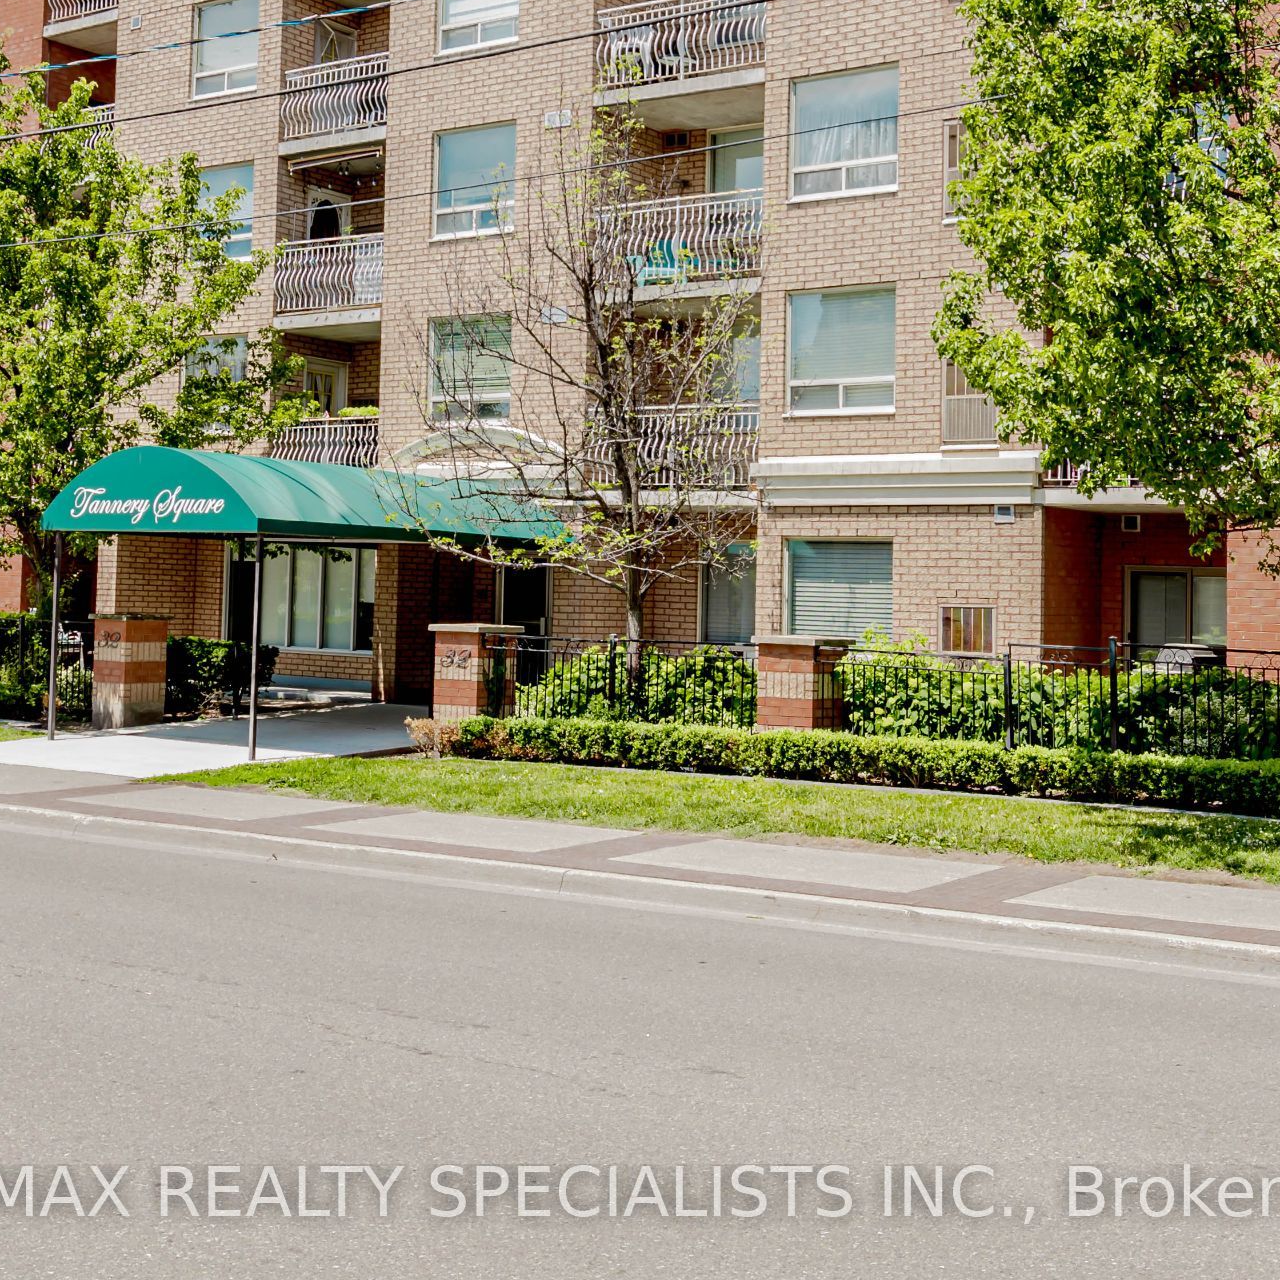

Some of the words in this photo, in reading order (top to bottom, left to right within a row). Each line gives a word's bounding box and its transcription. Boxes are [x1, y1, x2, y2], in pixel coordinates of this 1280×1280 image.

[70, 486, 150, 525] Tannery
[152, 485, 225, 524] Square
[97, 630, 122, 649] 32
[440, 649, 472, 669] 32
